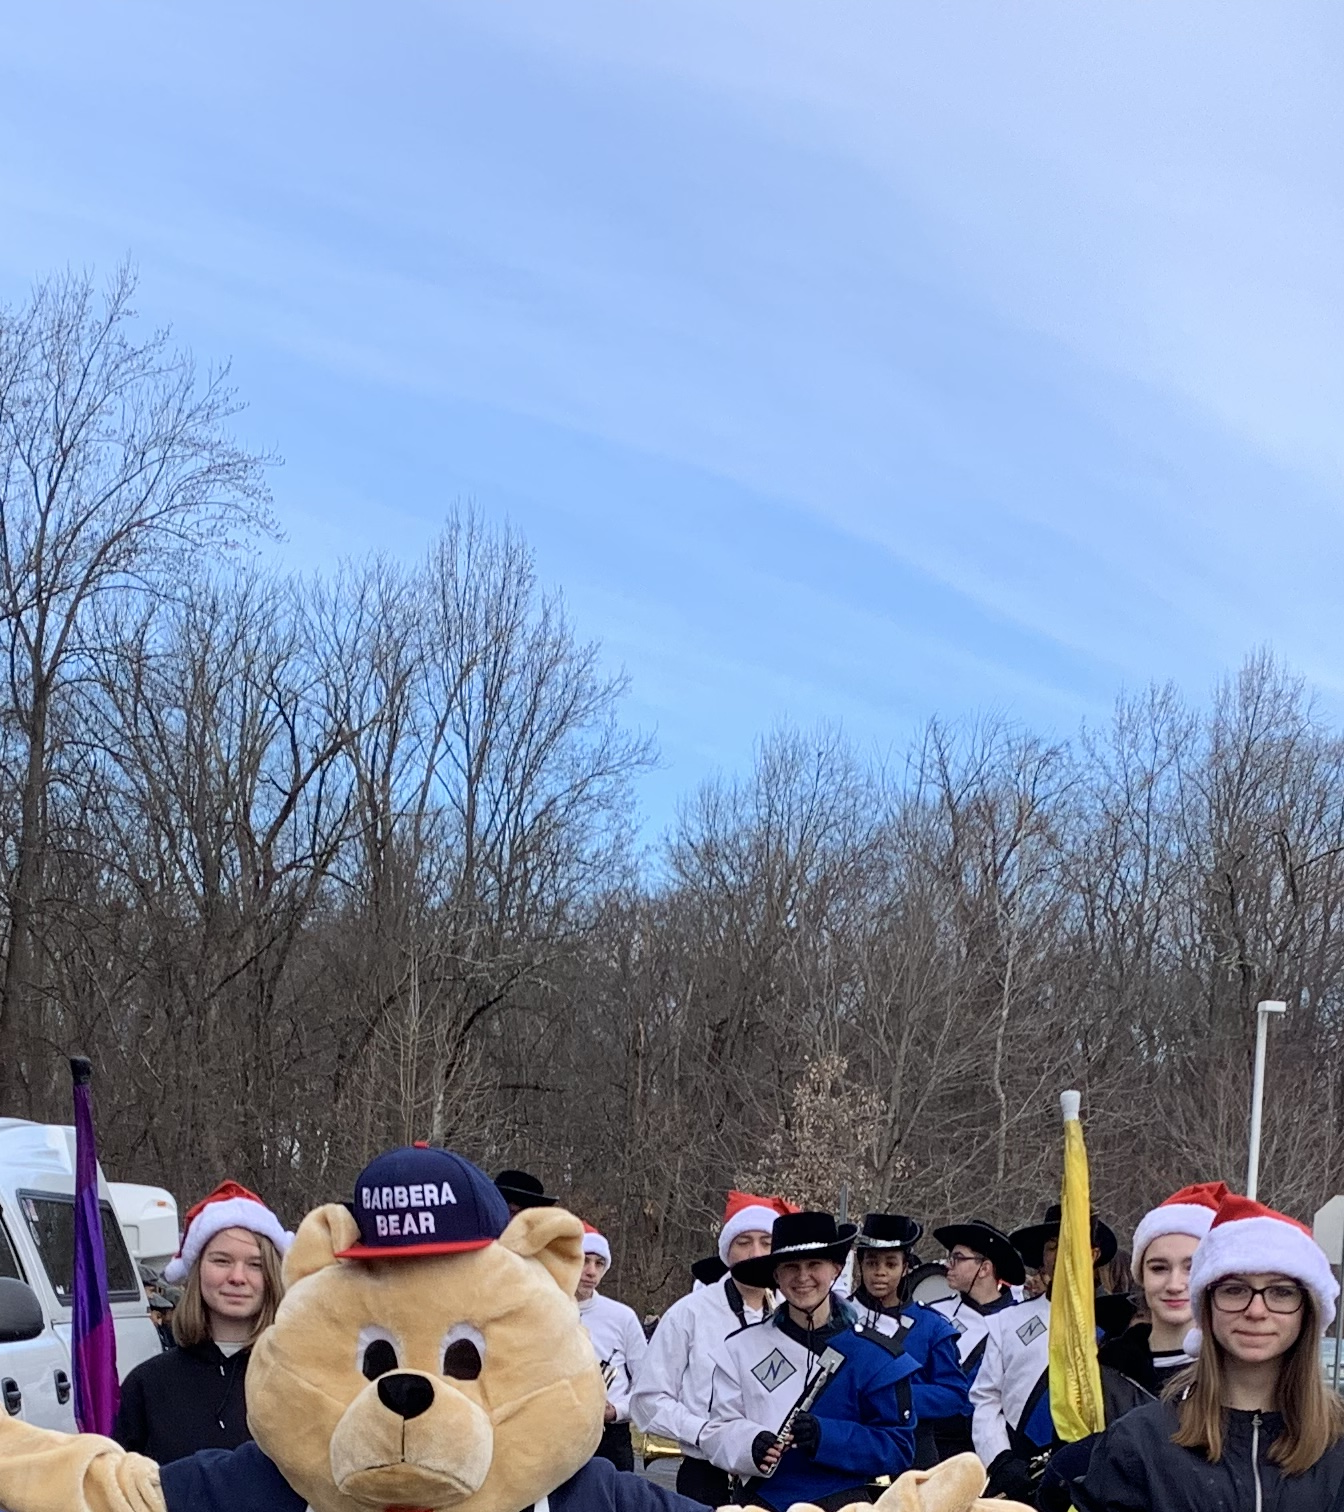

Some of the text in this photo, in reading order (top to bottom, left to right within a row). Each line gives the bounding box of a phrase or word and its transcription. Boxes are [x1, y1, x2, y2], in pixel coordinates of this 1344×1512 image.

[361, 1181, 458, 1210] BARBERA
[375, 1211, 436, 1237] BEAR
[760, 1359, 787, 1381] N
